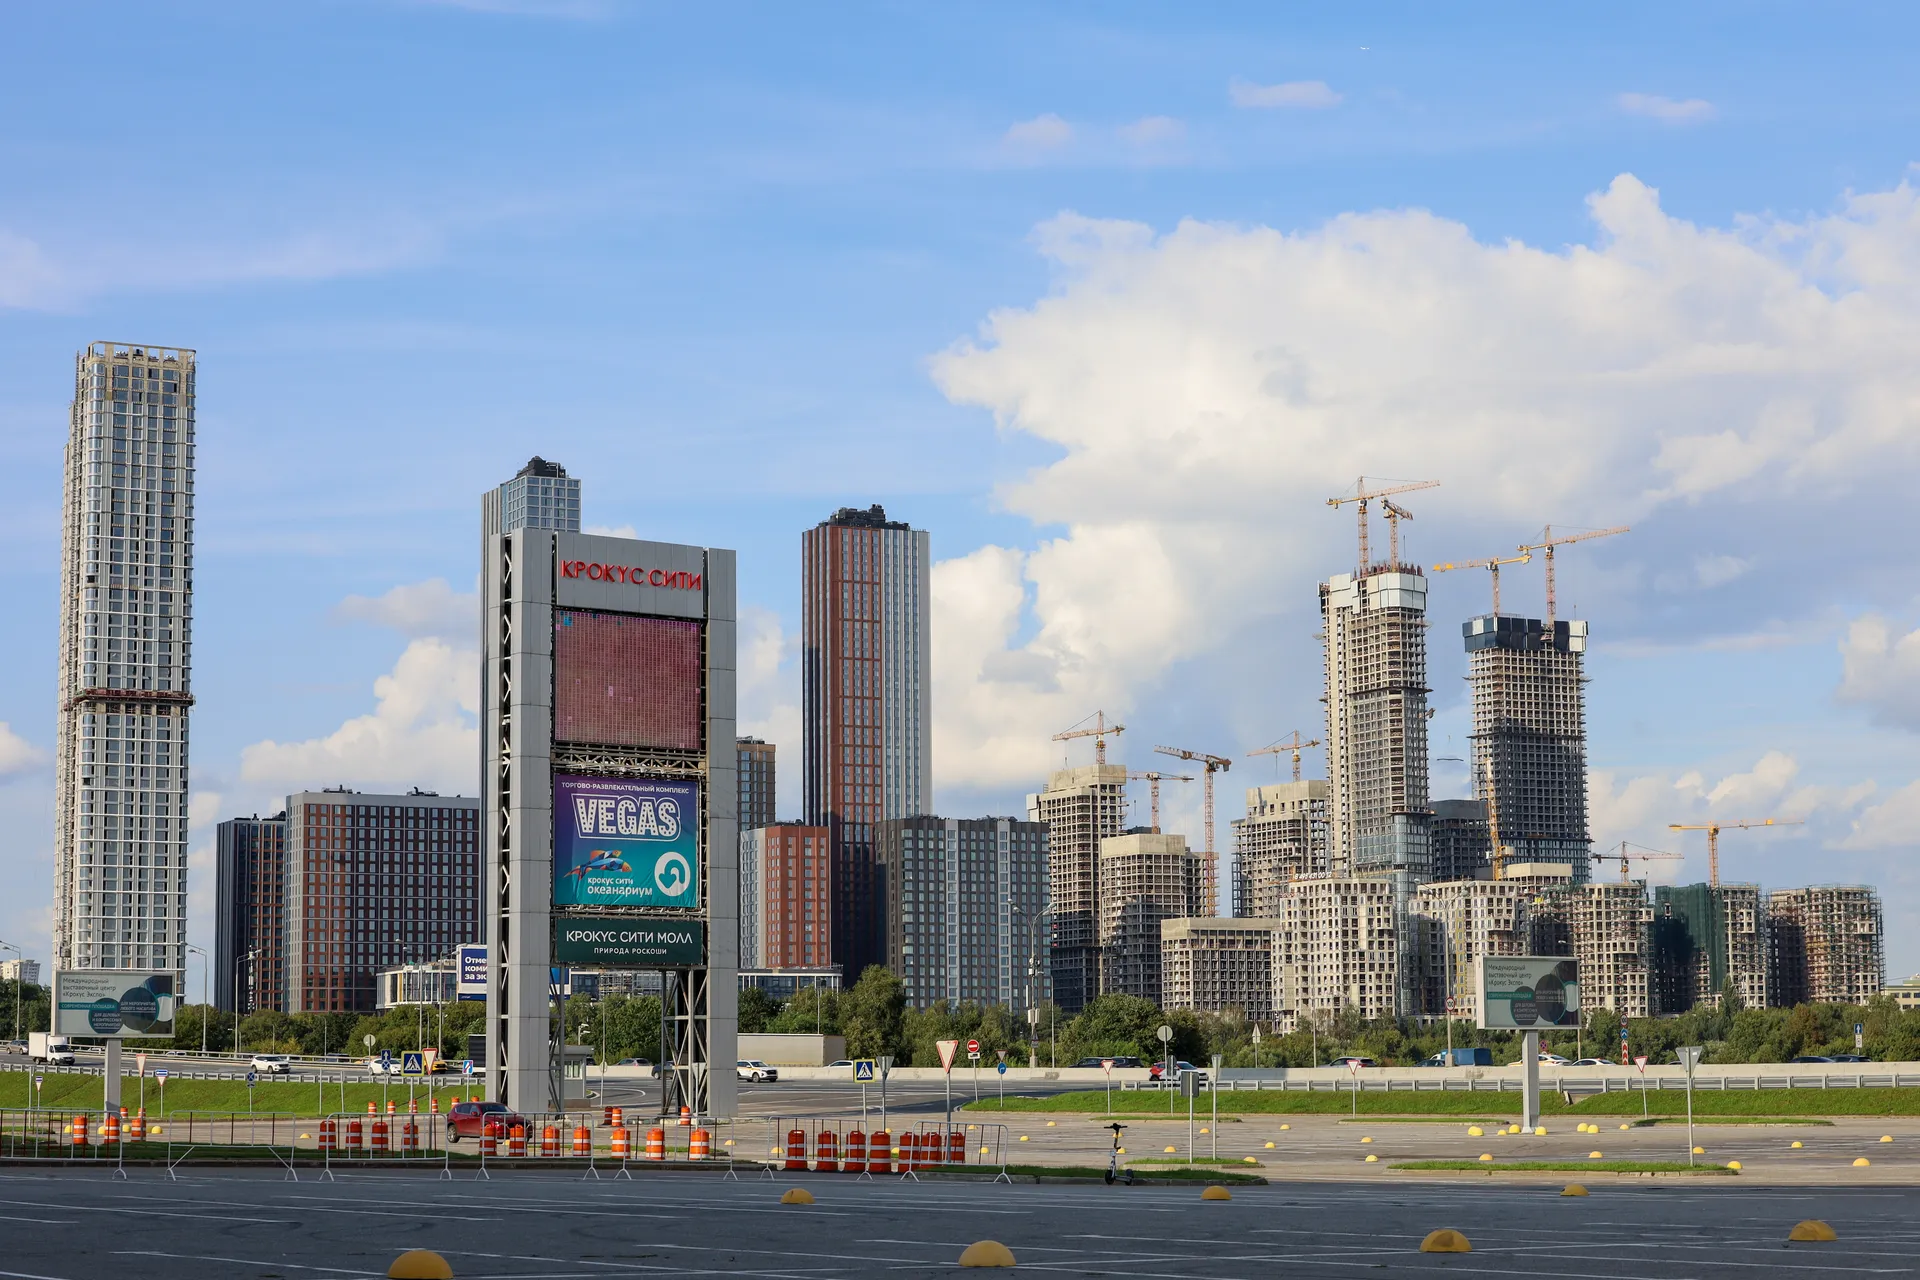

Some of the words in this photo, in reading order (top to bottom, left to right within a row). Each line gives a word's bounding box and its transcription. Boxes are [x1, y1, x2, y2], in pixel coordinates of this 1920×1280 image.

[561, 560, 644, 584] КРОКУС
[648, 569, 701, 590] СИТИ
[561, 782, 655, 793] ТОРГОВО-РАЗВЛЕКАТЕЛЬНЫЙ
[656, 786, 689, 794] КОМПЛЕКС
[576, 798, 678, 837] VEGAS
[587, 877, 613, 885] крокус
[615, 877, 633, 885] сити
[587, 886, 653, 898] океанариум
[566, 930, 617, 943] КРОКУС
[619, 931, 654, 943] СИТИ
[657, 932, 693, 944] МОЛЛ
[594, 947, 630, 955] ПРИРОДА
[631, 947, 667, 955] РОСКОШИ
[465, 956, 487, 964] Отме
